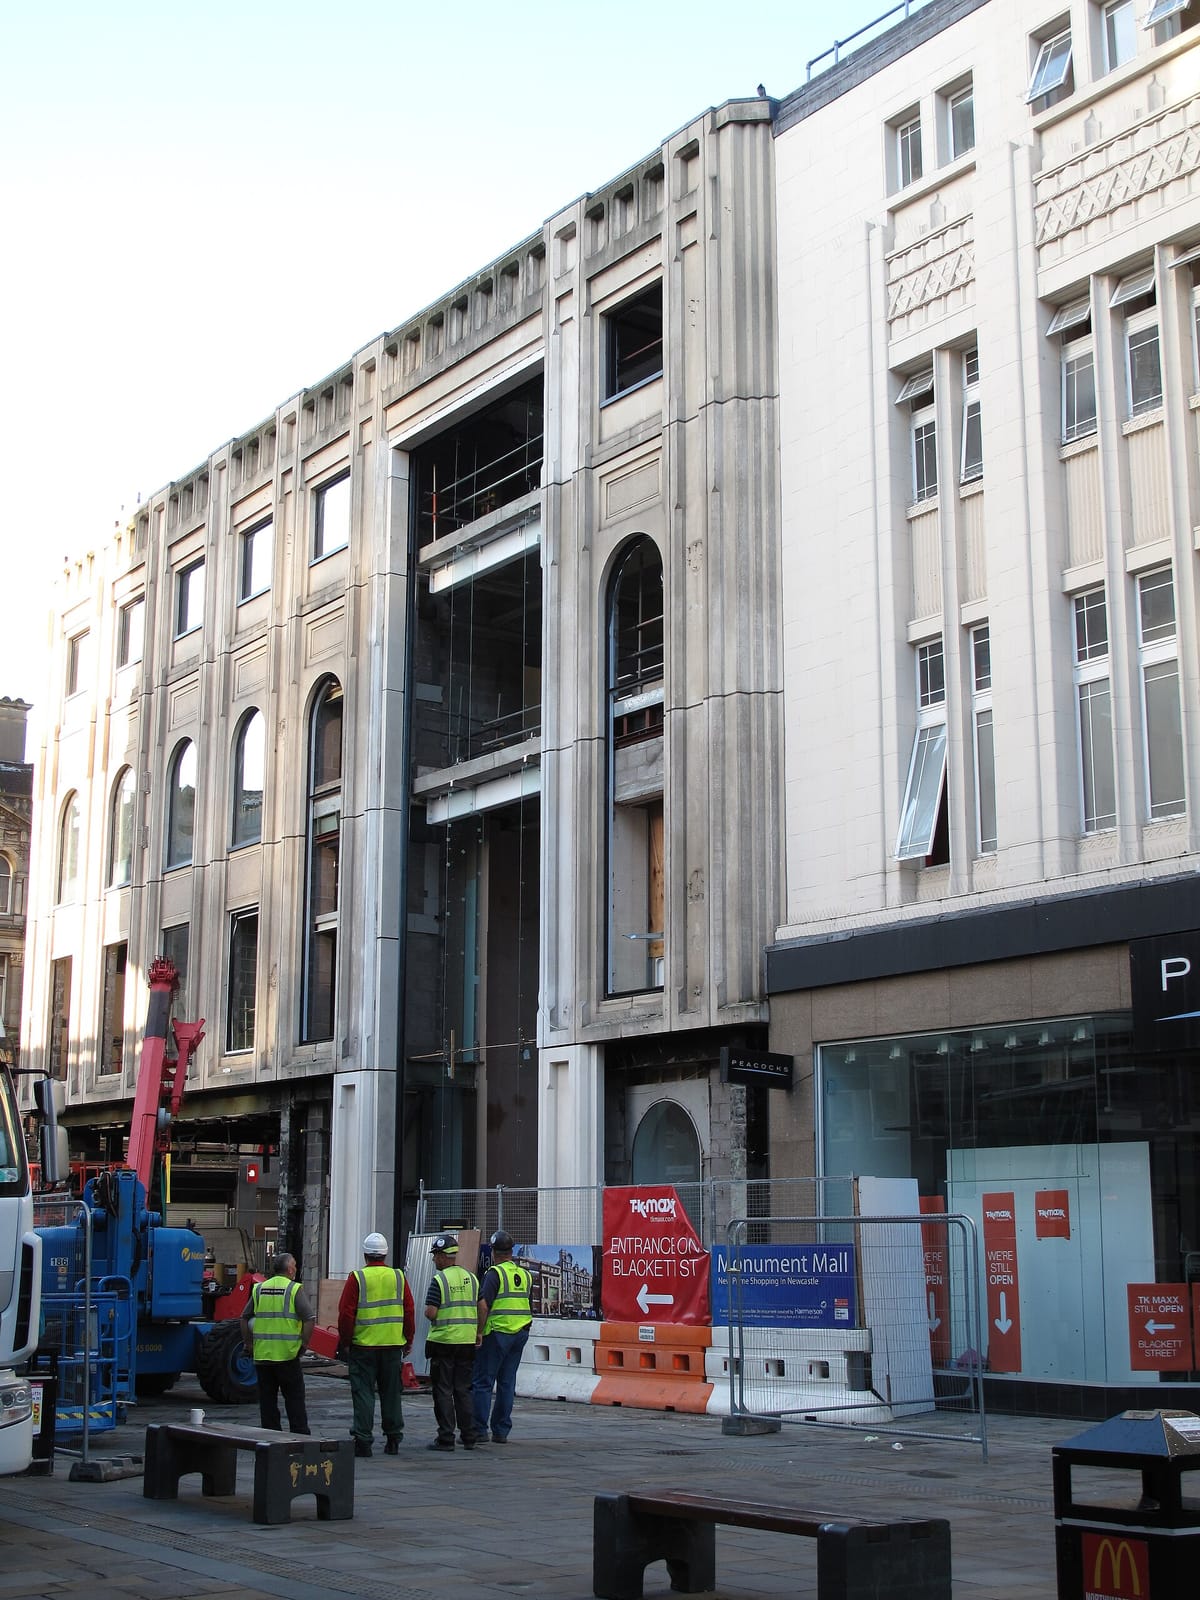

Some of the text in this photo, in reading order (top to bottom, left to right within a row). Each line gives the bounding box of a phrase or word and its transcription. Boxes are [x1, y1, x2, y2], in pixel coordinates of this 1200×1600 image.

[731, 1059, 789, 1073] PEACOCKS
[610, 1237, 700, 1255] ENTRANCE ON
[51, 1257, 68, 1266] 186
[717, 1252, 848, 1273] Monument Mall
[612, 1259, 700, 1277] BLACKETT ST
[990, 1262, 1013, 1273] STILL
[750, 1277, 779, 1287] Shopping
[780, 1277, 786, 1285] in
[787, 1277, 819, 1285] Newcastle
[926, 1275, 943, 1285] PEN
[989, 1274, 1014, 1285] OPEN
[1138, 1296, 1179, 1304] TK MAXX
[1134, 1305, 1184, 1313] STILL OPEN
[1138, 1340, 1184, 1348] BLACKETT
[1144, 1349, 1177, 1357] STREET
